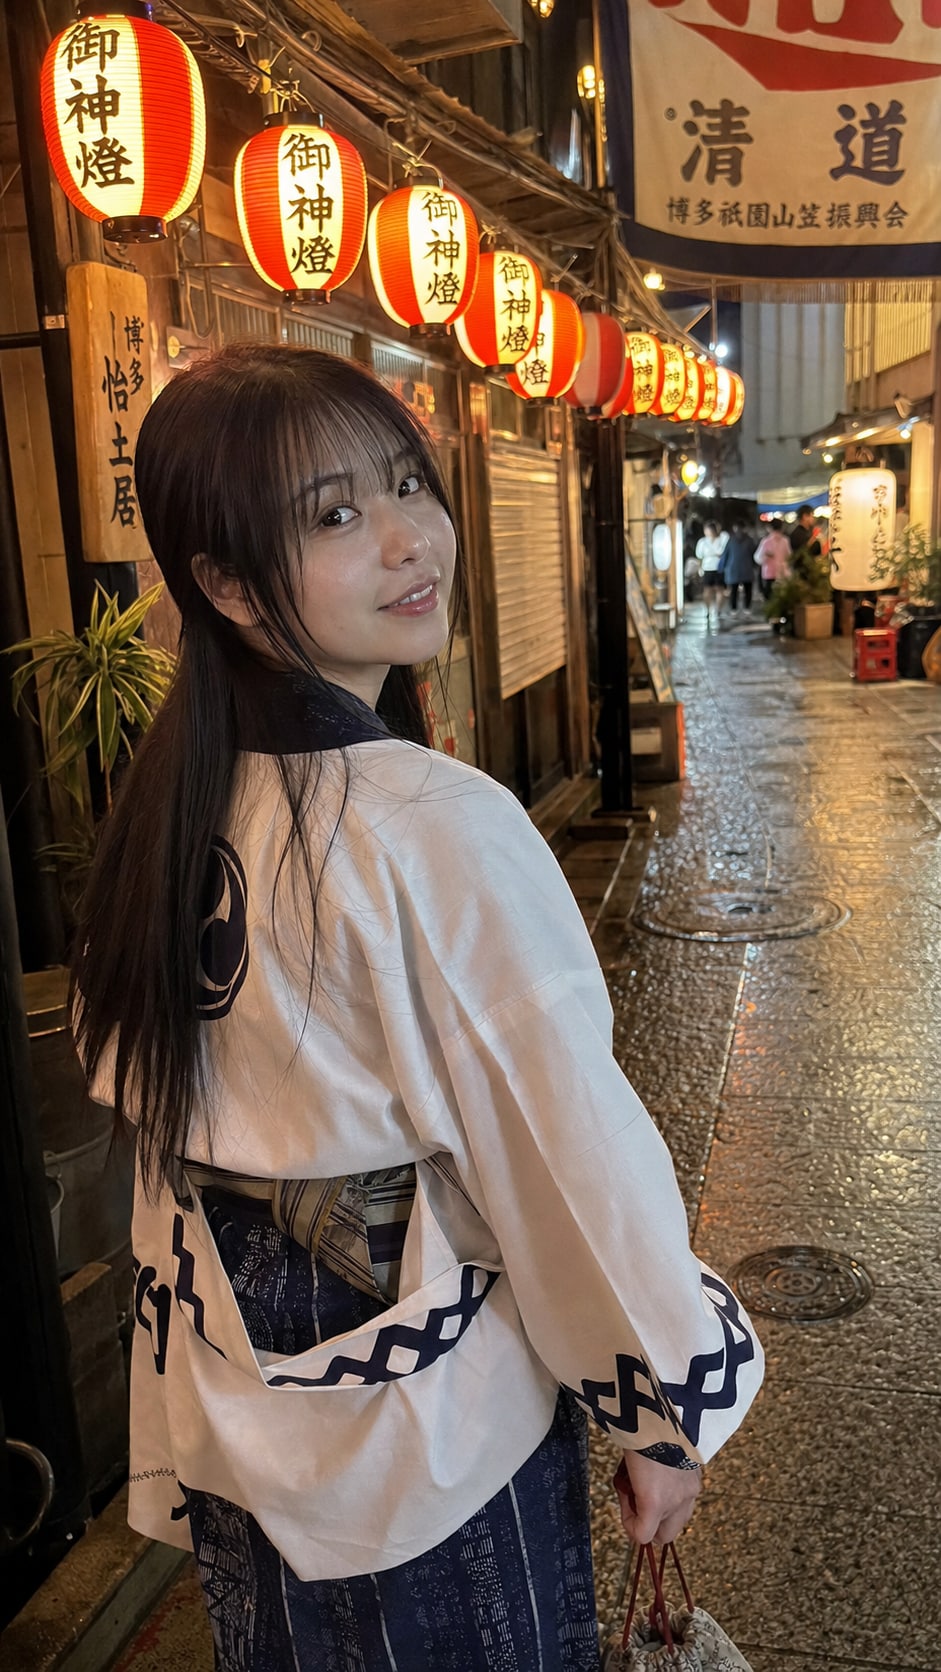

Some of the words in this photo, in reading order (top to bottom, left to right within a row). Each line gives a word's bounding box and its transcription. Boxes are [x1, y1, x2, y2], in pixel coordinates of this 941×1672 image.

[60, 22, 135, 189] 御神燈
[680, 98, 907, 188] 清道
[282, 133, 335, 275] 御神燈
[420, 191, 461, 305] 御神燈
[665, 196, 909, 229] 博多祇園山笠振興会
[499, 256, 532, 353] 御神燈
[124, 315, 145, 396] 博多
